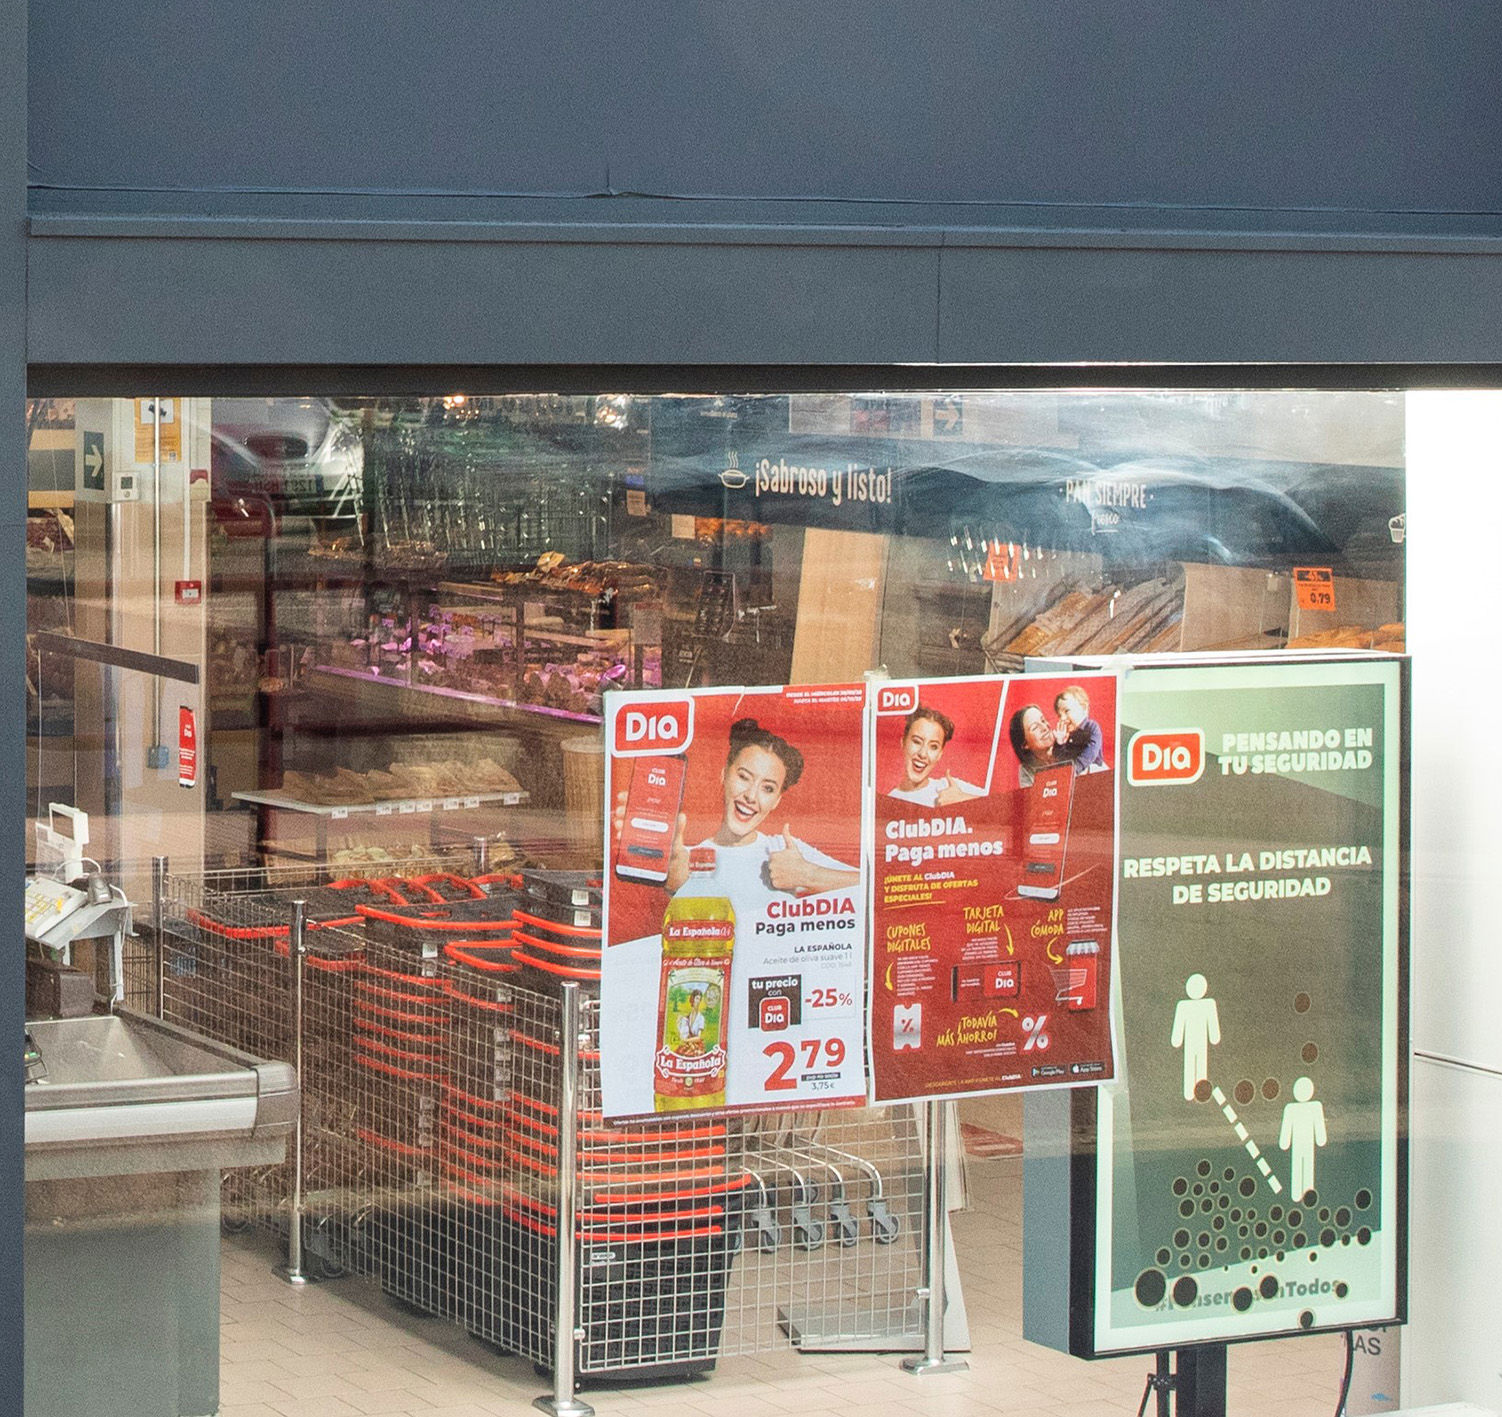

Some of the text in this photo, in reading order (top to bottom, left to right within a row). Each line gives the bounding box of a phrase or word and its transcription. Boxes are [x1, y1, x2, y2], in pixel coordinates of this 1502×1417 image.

[755, 458, 892, 506] ¡Sabroso y listo!
[1096, 480, 1147, 509] SIEMPRE
[1222, 728, 1373, 753] PENSANDO EN
[1218, 750, 1372, 775] TU SEGURIDAD
[885, 816, 973, 840] ClubDIA.
[885, 840, 1003, 866] Paga menos
[1123, 846, 1373, 878] RESPETA LA DISTANCIA
[891, 882, 930, 893] DISFRUTA
[931, 882, 942, 890] DE
[943, 879, 979, 889] OFERTAS
[913, 873, 923, 881] AL
[884, 892, 932, 903] ESPECIALES!
[1173, 877, 1331, 904] DE SEGURIDAD
[767, 897, 855, 919] ClubDIA
[963, 904, 1004, 920] TARJETA
[1047, 908, 1064, 922] APP
[756, 919, 855, 937] Paga menos
[887, 922, 926, 940] CUPONES
[966, 920, 1000, 934] DIGITAL
[1030, 919, 1064, 938] CÓMODA
[808, 942, 852, 952] ESPAÑOLA
[887, 936, 931, 953] DIGITALES
[752, 976, 798, 990] tu precio
[936, 1028, 998, 1047] MÁS AHORRO!
